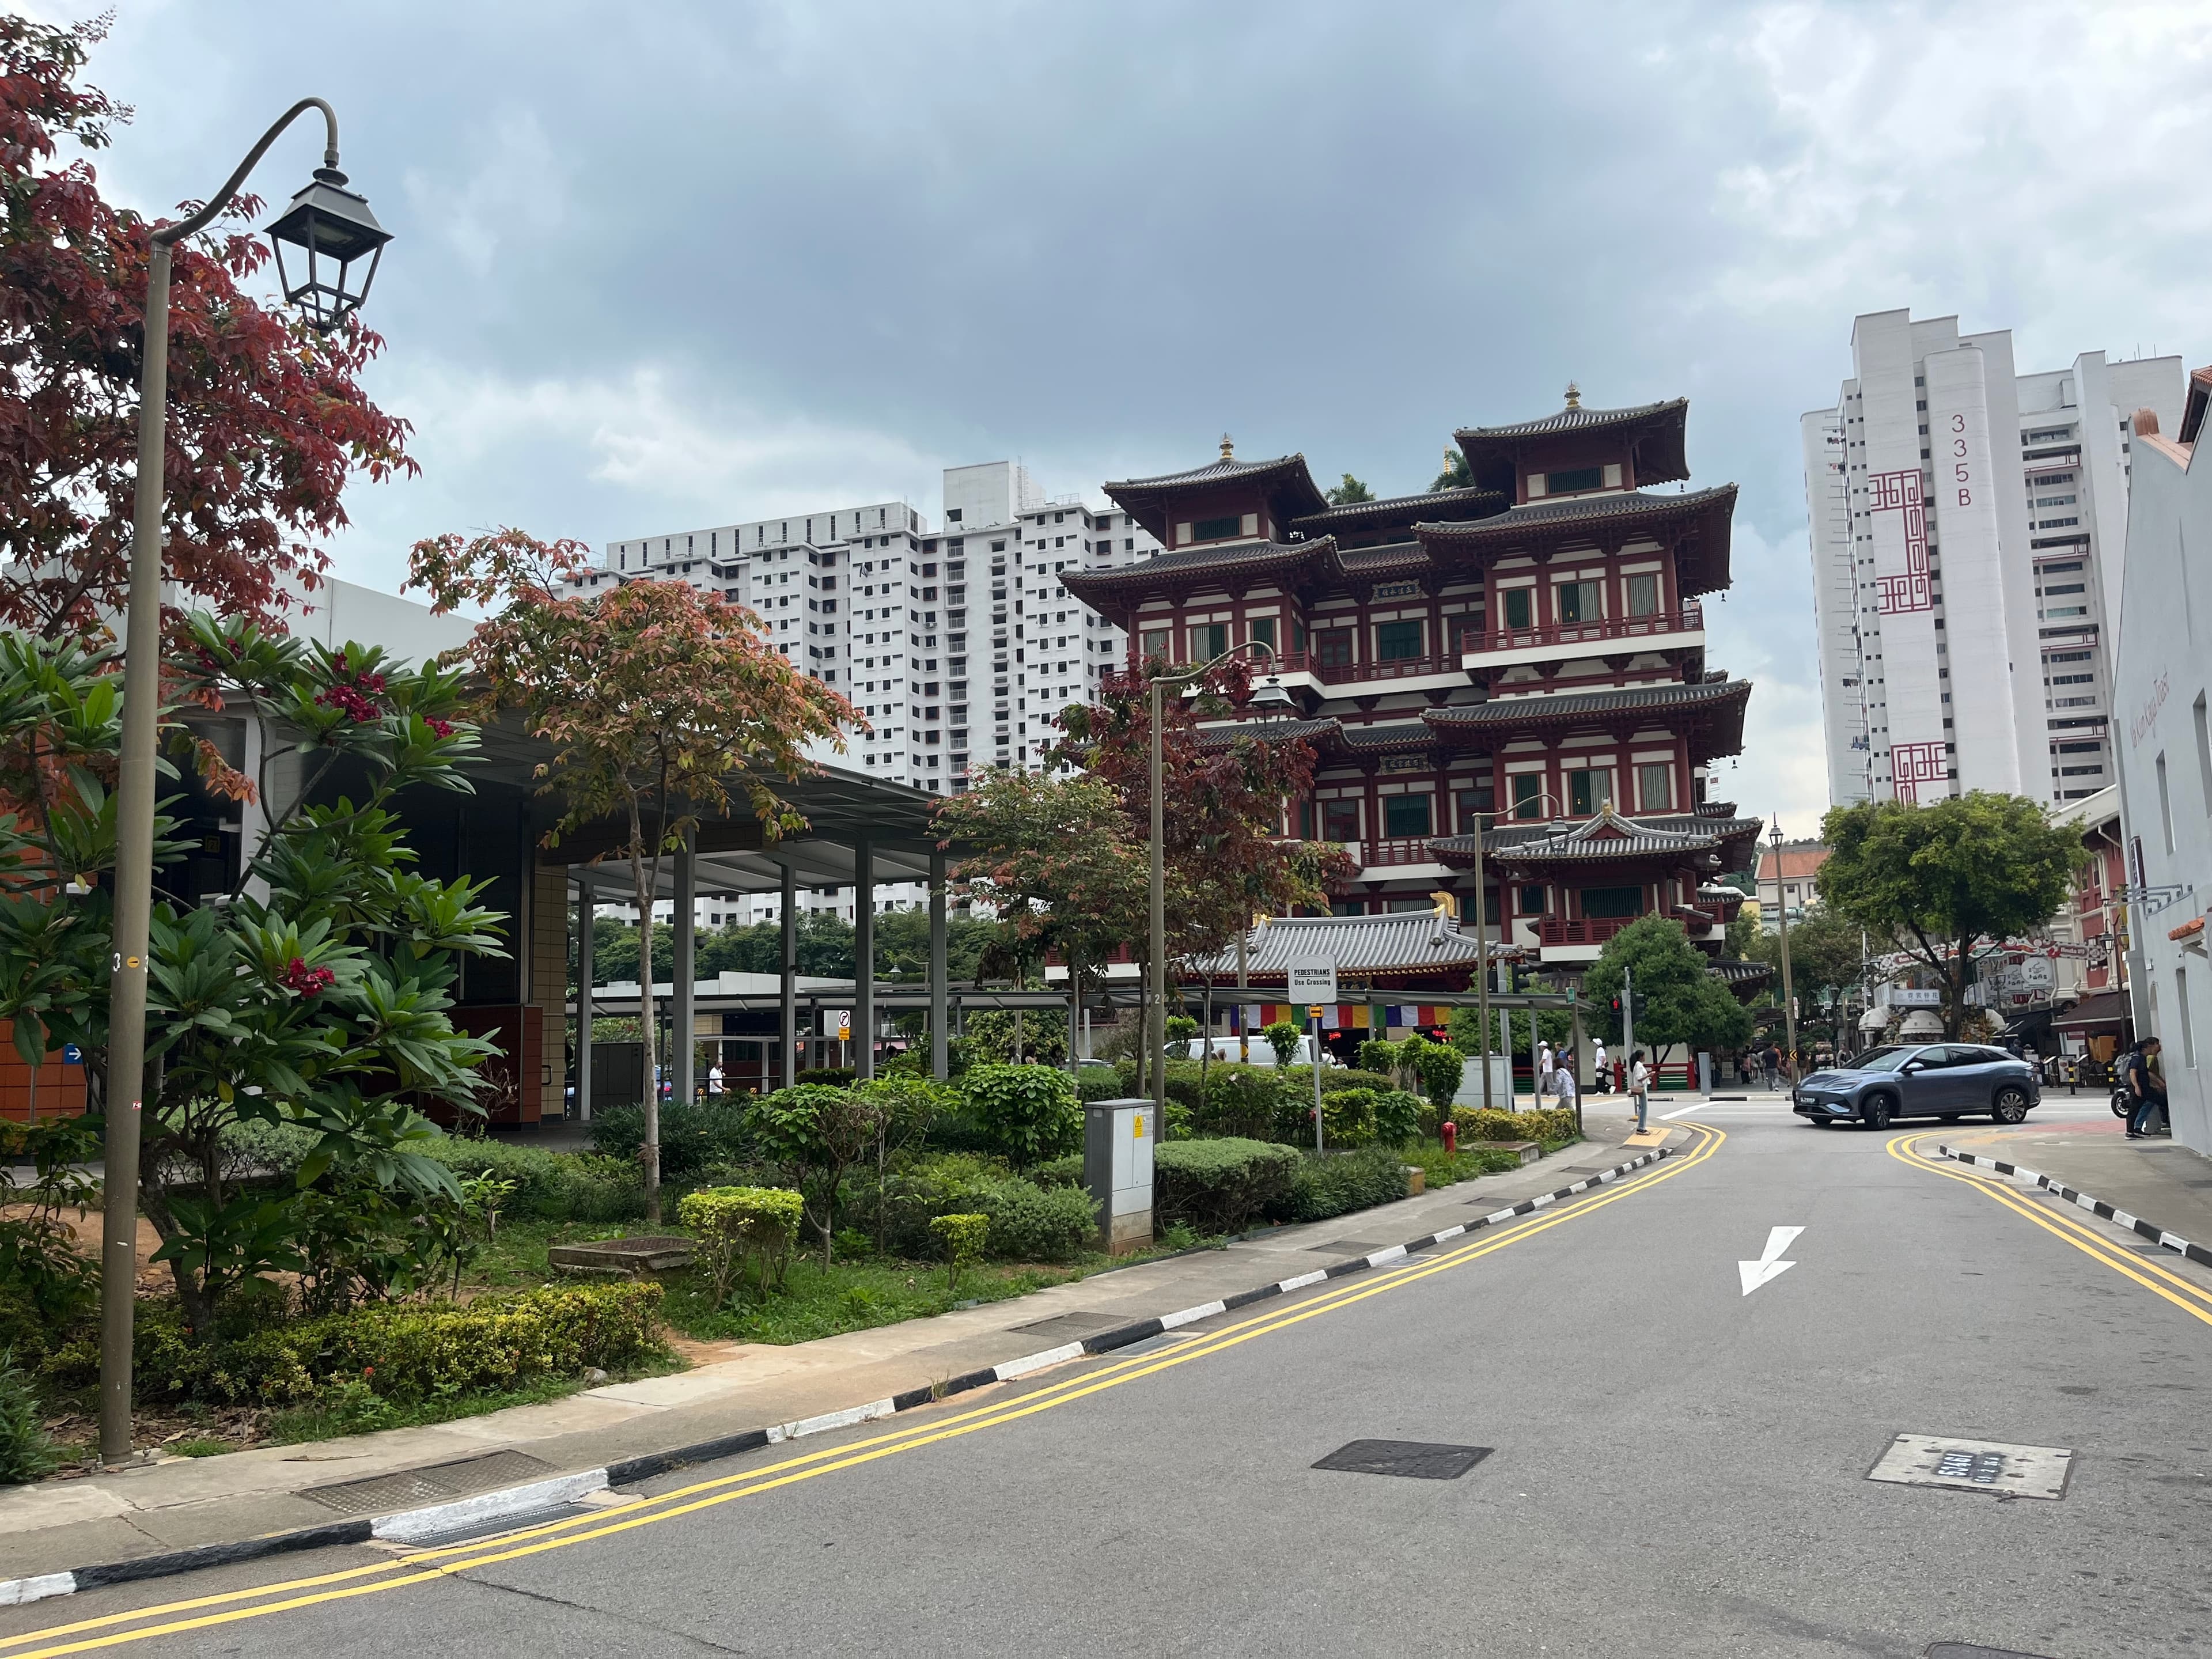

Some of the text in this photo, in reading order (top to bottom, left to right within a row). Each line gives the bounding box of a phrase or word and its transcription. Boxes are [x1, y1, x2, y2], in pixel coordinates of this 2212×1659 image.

[1952, 414, 1971, 506] 335B
[113, 952, 121, 972] 3
[1154, 994, 1160, 1004] 2
